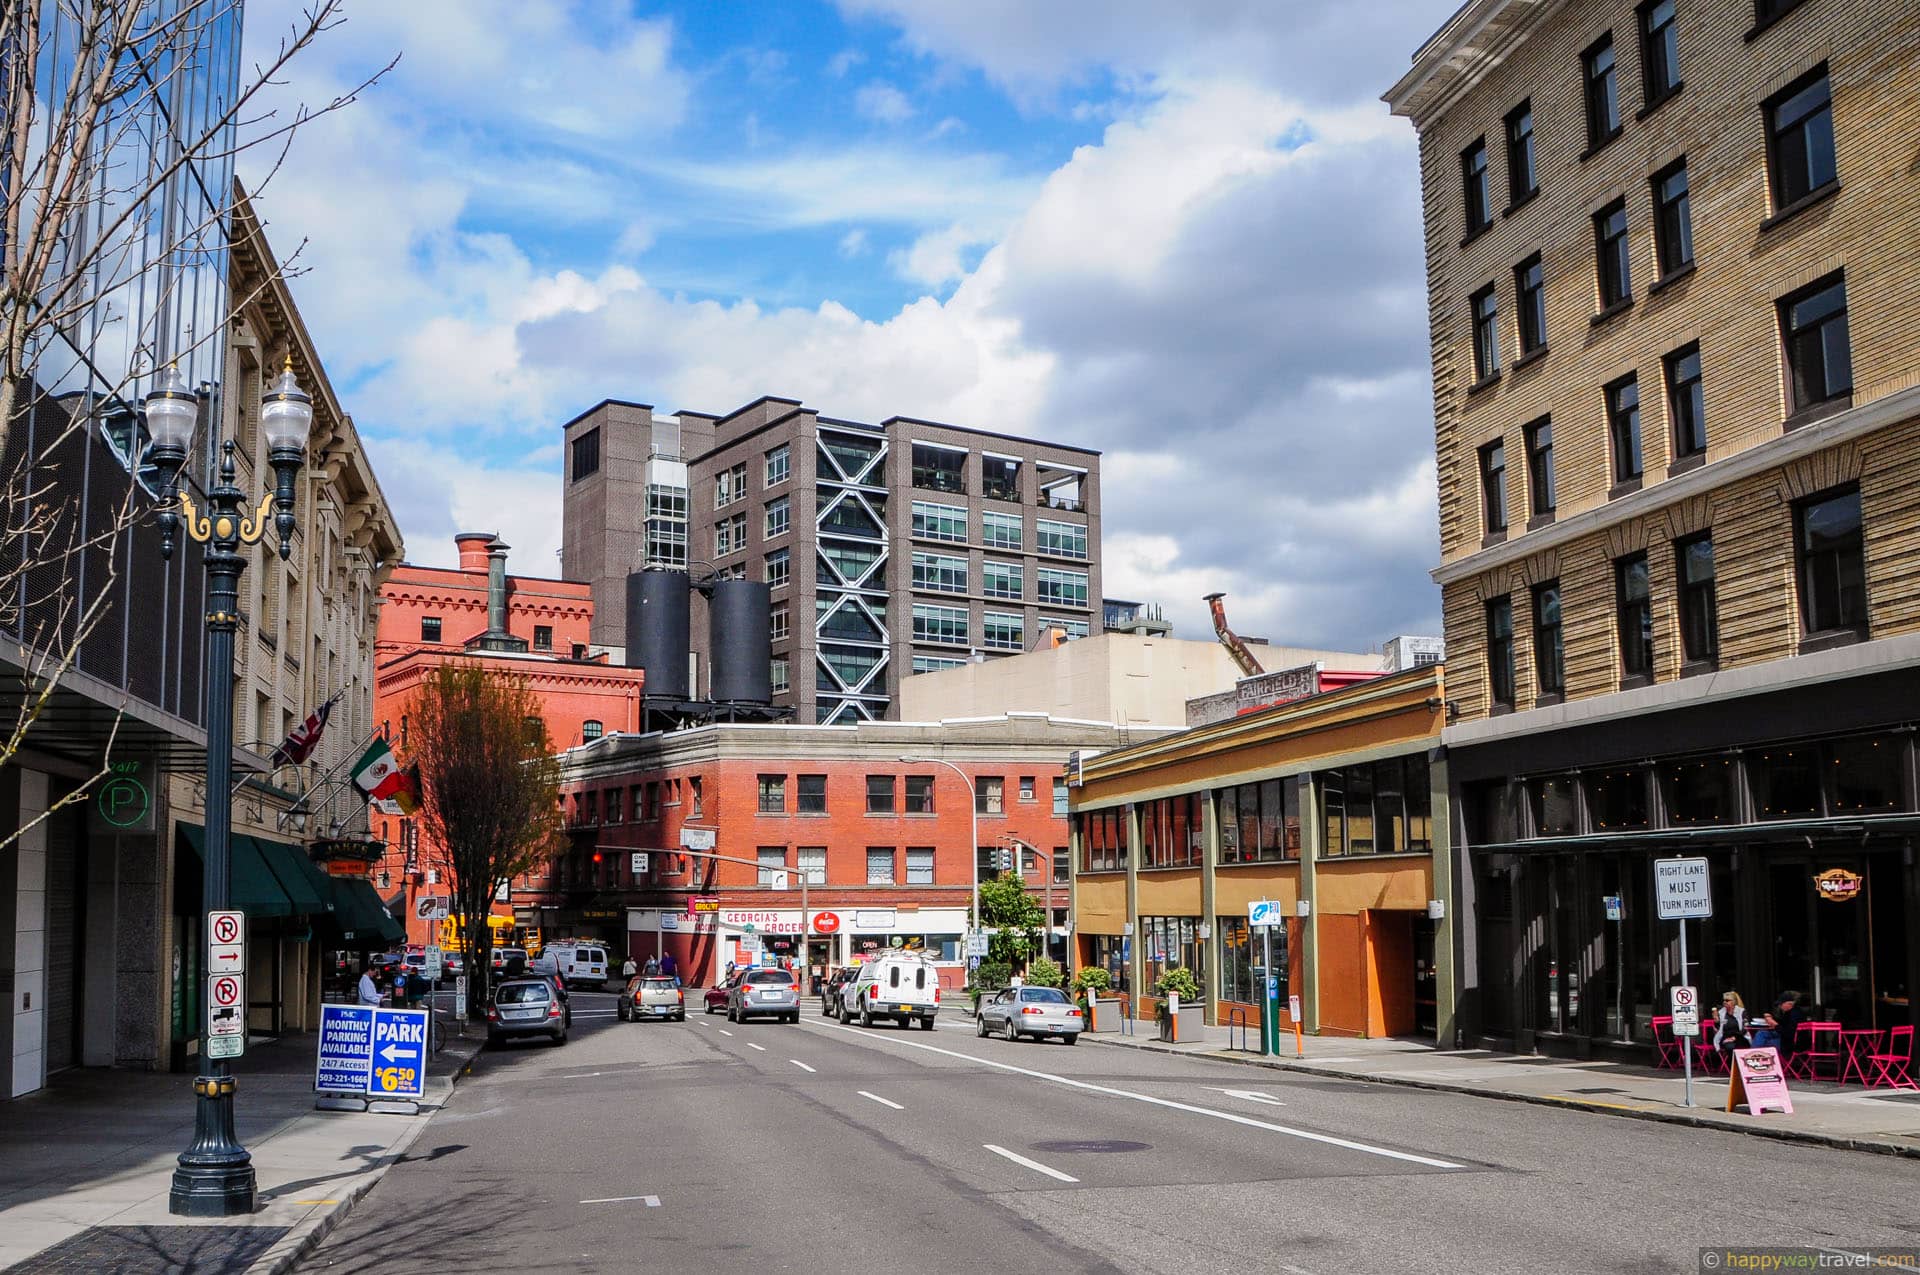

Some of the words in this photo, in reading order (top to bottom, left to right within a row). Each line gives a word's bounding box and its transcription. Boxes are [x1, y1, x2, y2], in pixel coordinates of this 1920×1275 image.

[1659, 866, 1682, 876] RIGHT
[1684, 865, 1705, 875] LANE
[1669, 881, 1697, 893] MUST
[1662, 900, 1682, 910] TURN
[1684, 898, 1708, 909] RIGHT
[727, 913, 778, 923] GEORGIA'S
[326, 1019, 370, 1032] MONTHLY
[326, 1031, 367, 1043] PARKING
[376, 1022, 423, 1043] PARK
[321, 1042, 370, 1055] AVAILABLE
